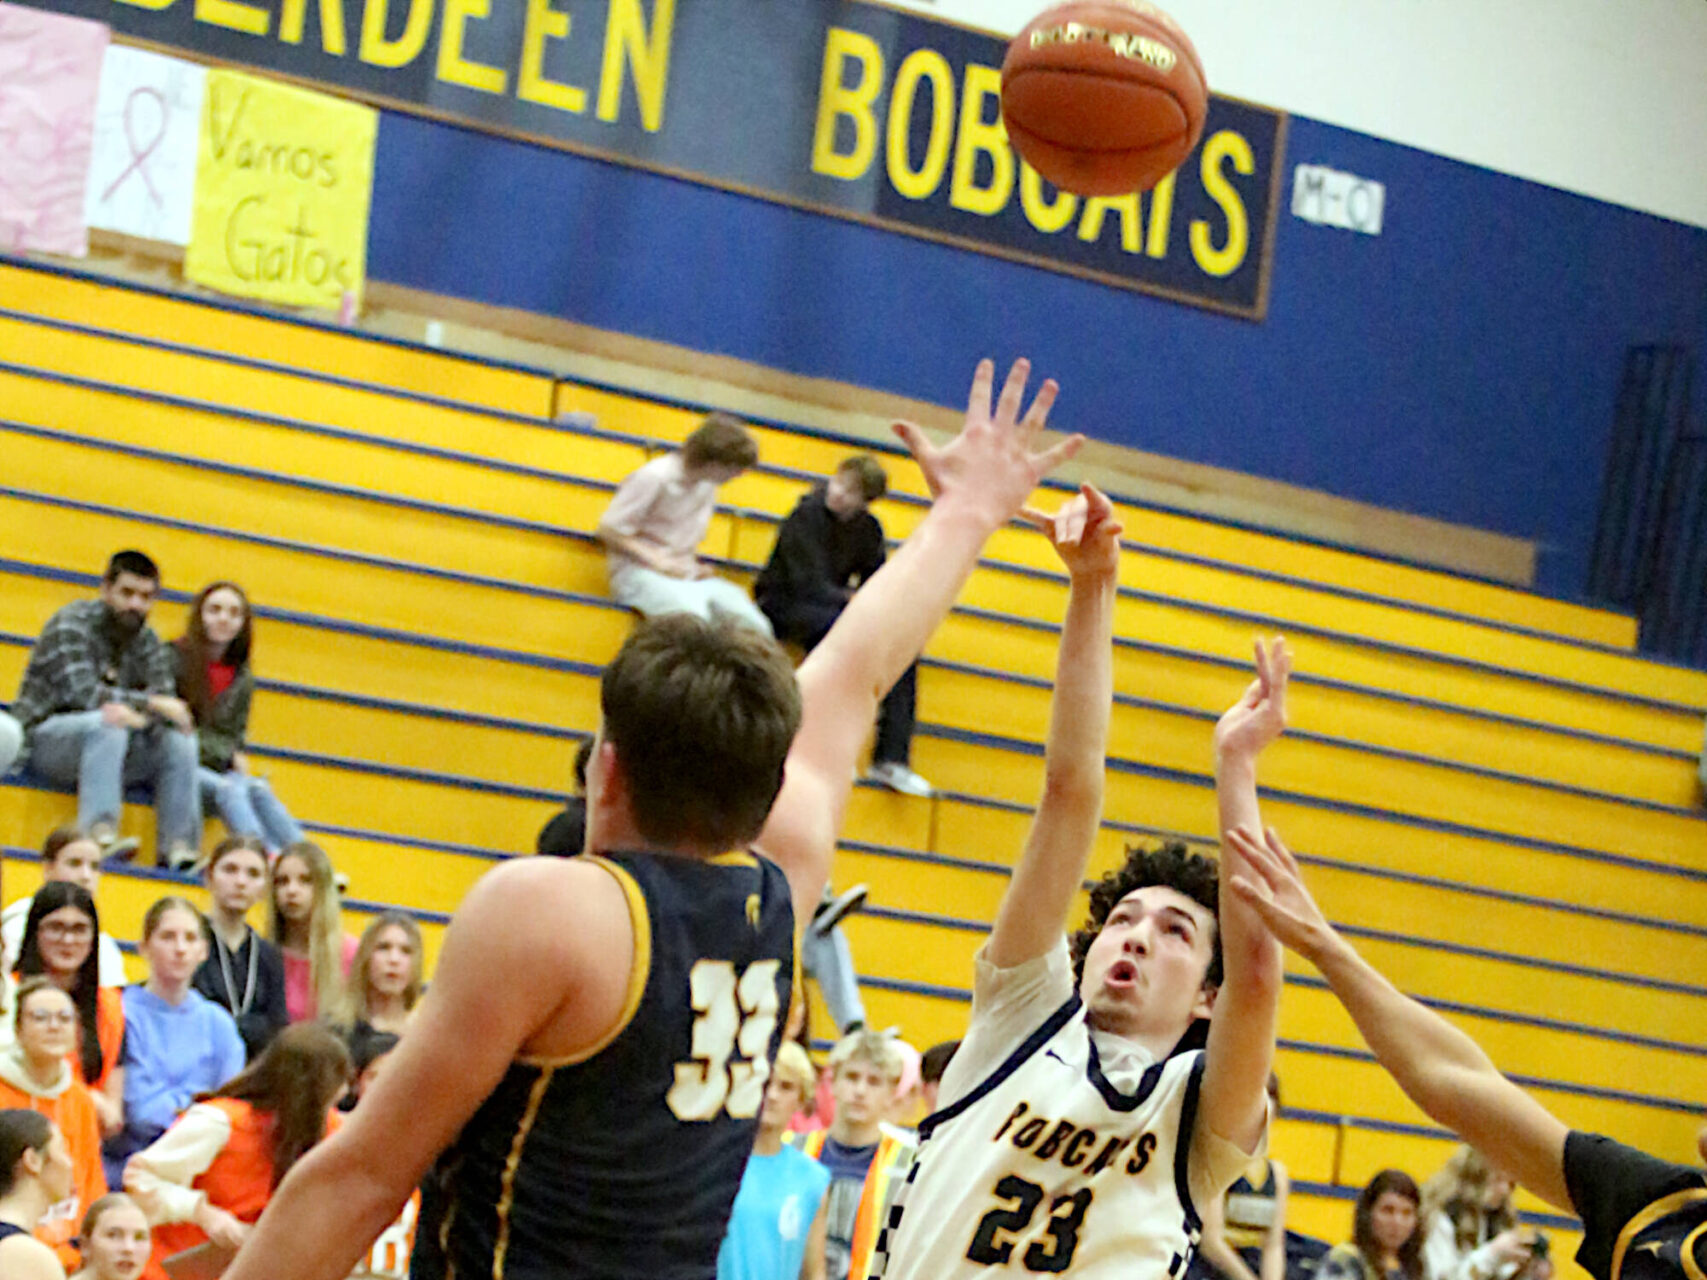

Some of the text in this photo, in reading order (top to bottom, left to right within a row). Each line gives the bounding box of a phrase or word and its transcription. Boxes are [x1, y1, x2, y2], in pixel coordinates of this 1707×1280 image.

[209, 80, 337, 188] Vamos
[225, 194, 351, 298] Gatos
[665, 957, 782, 1122] 33
[993, 1101, 1157, 1176] OBCAS
[966, 1174, 1094, 1274] 23
